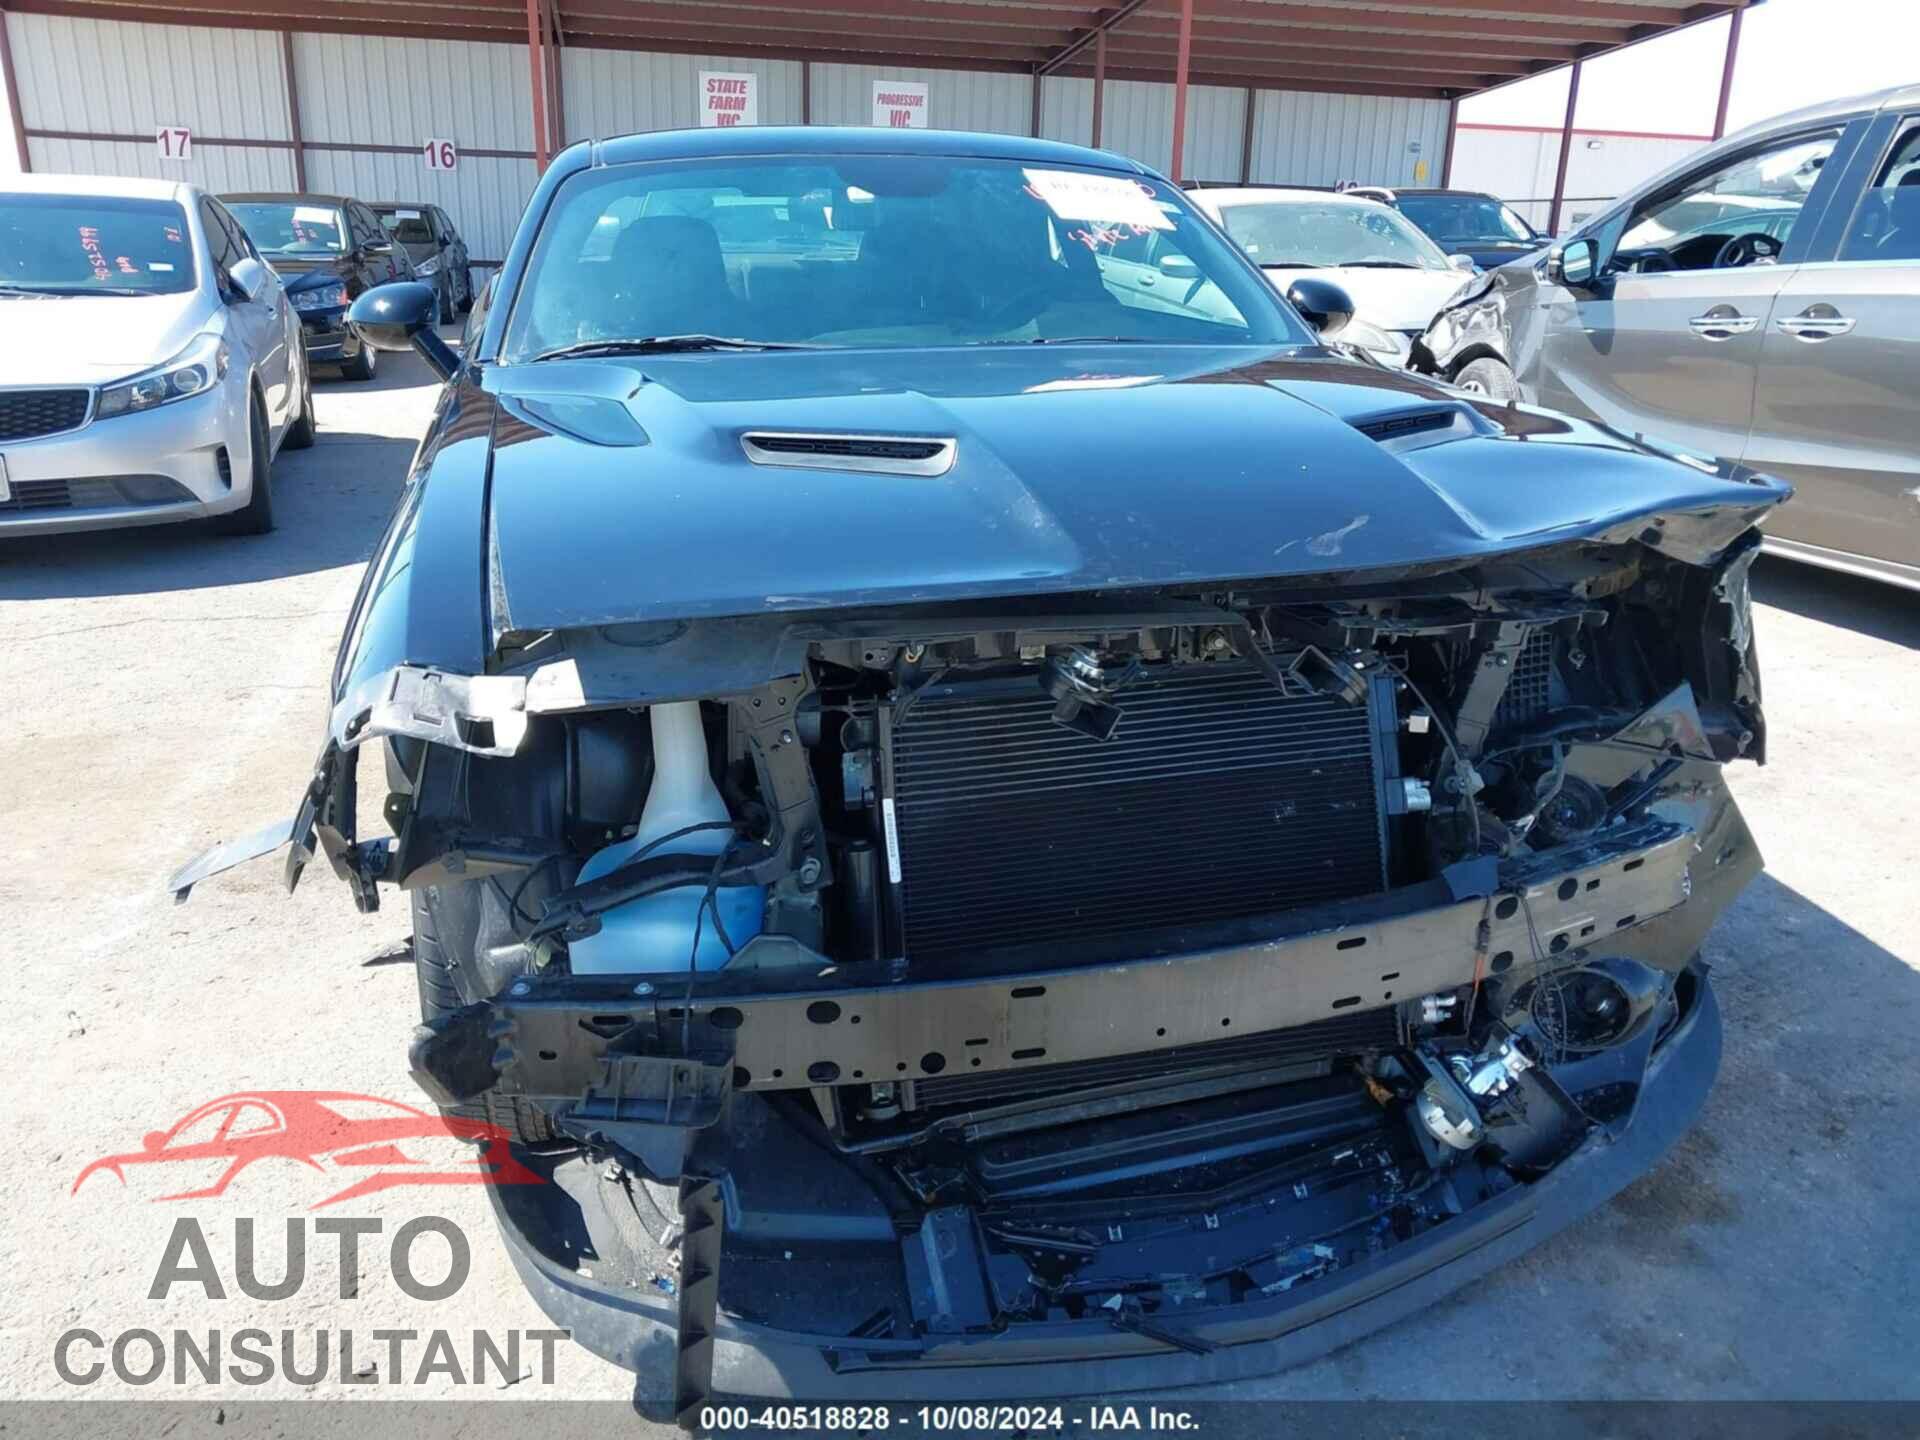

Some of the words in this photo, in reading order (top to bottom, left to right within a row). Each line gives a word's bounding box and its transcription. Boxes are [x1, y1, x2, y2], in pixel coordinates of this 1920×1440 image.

[707, 78, 747, 94] STATE
[708, 95, 746, 110] FARM
[877, 93, 923, 107] PROGRESSIVE
[890, 109, 910, 128] VIC
[159, 129, 188, 157] 17
[425, 141, 454, 168] 16
